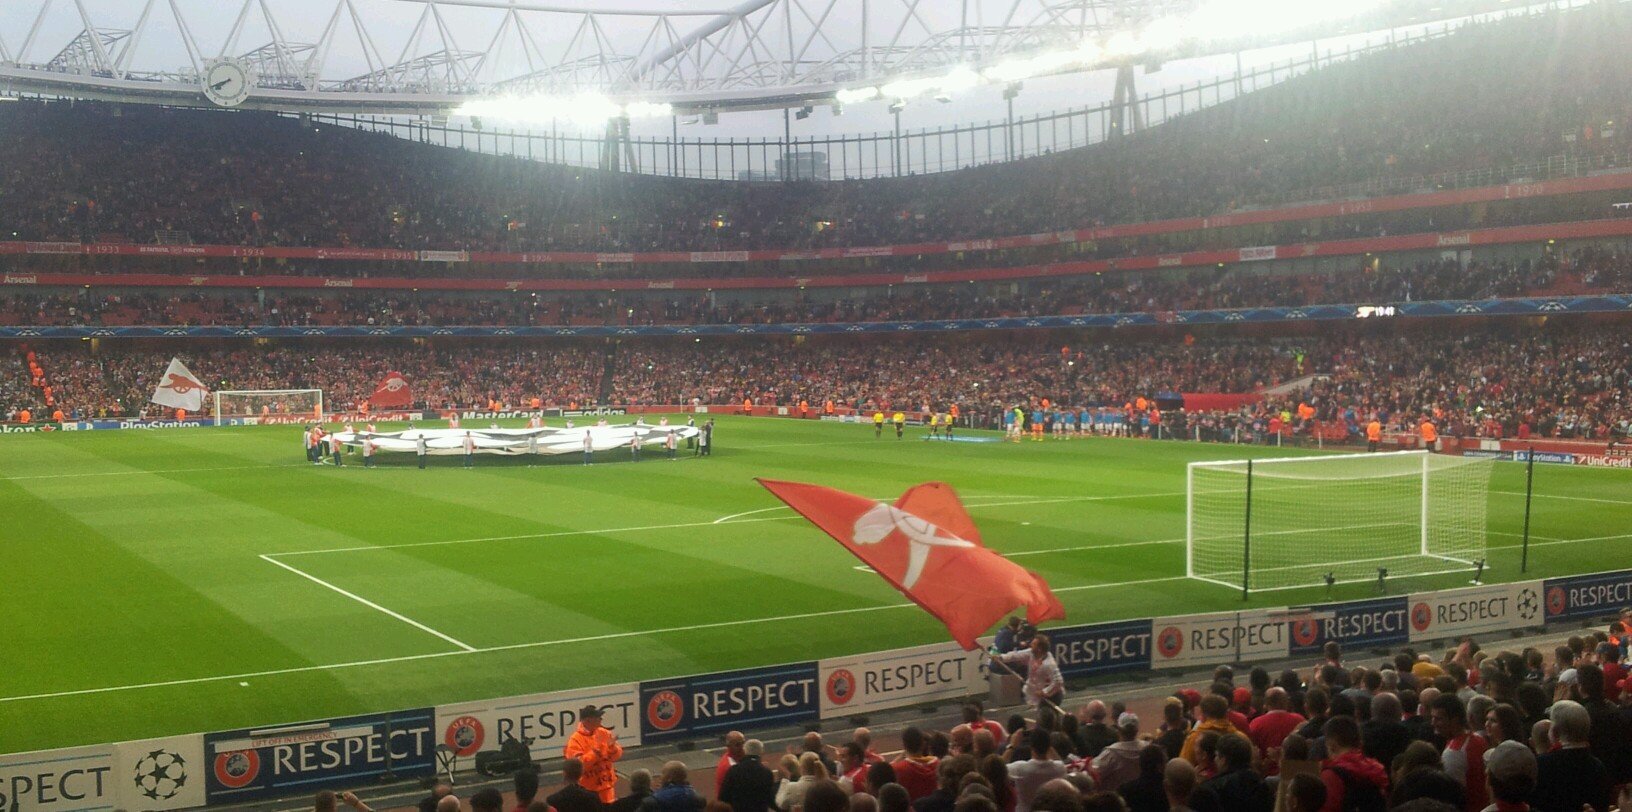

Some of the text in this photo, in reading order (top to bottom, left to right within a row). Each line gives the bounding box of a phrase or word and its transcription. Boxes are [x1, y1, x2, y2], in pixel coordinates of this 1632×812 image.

[1437, 234, 1470, 245] Arsenal
[4, 275, 37, 284] Arsenal
[324, 279, 353, 287] Arsenal
[462, 410, 544, 420] MasterCard
[583, 408, 625, 416] adidas
[120, 420, 200, 430] PlayStation
[1528, 453, 1562, 463] ayStation
[1586, 455, 1632, 467] UniCredit
[1570, 582, 1632, 607] RESPECT
[1437, 597, 1508, 624] RESPECT
[1324, 609, 1406, 639] RESPECT
[1191, 622, 1285, 650] RESPECT
[1055, 633, 1150, 665] RESPECT
[865, 657, 967, 694] RESPECT
[694, 679, 815, 719] RESPECT
[452, 717, 477, 729] UEFA
[497, 702, 634, 745] RESPCT
[273, 727, 430, 775] RESPECT
